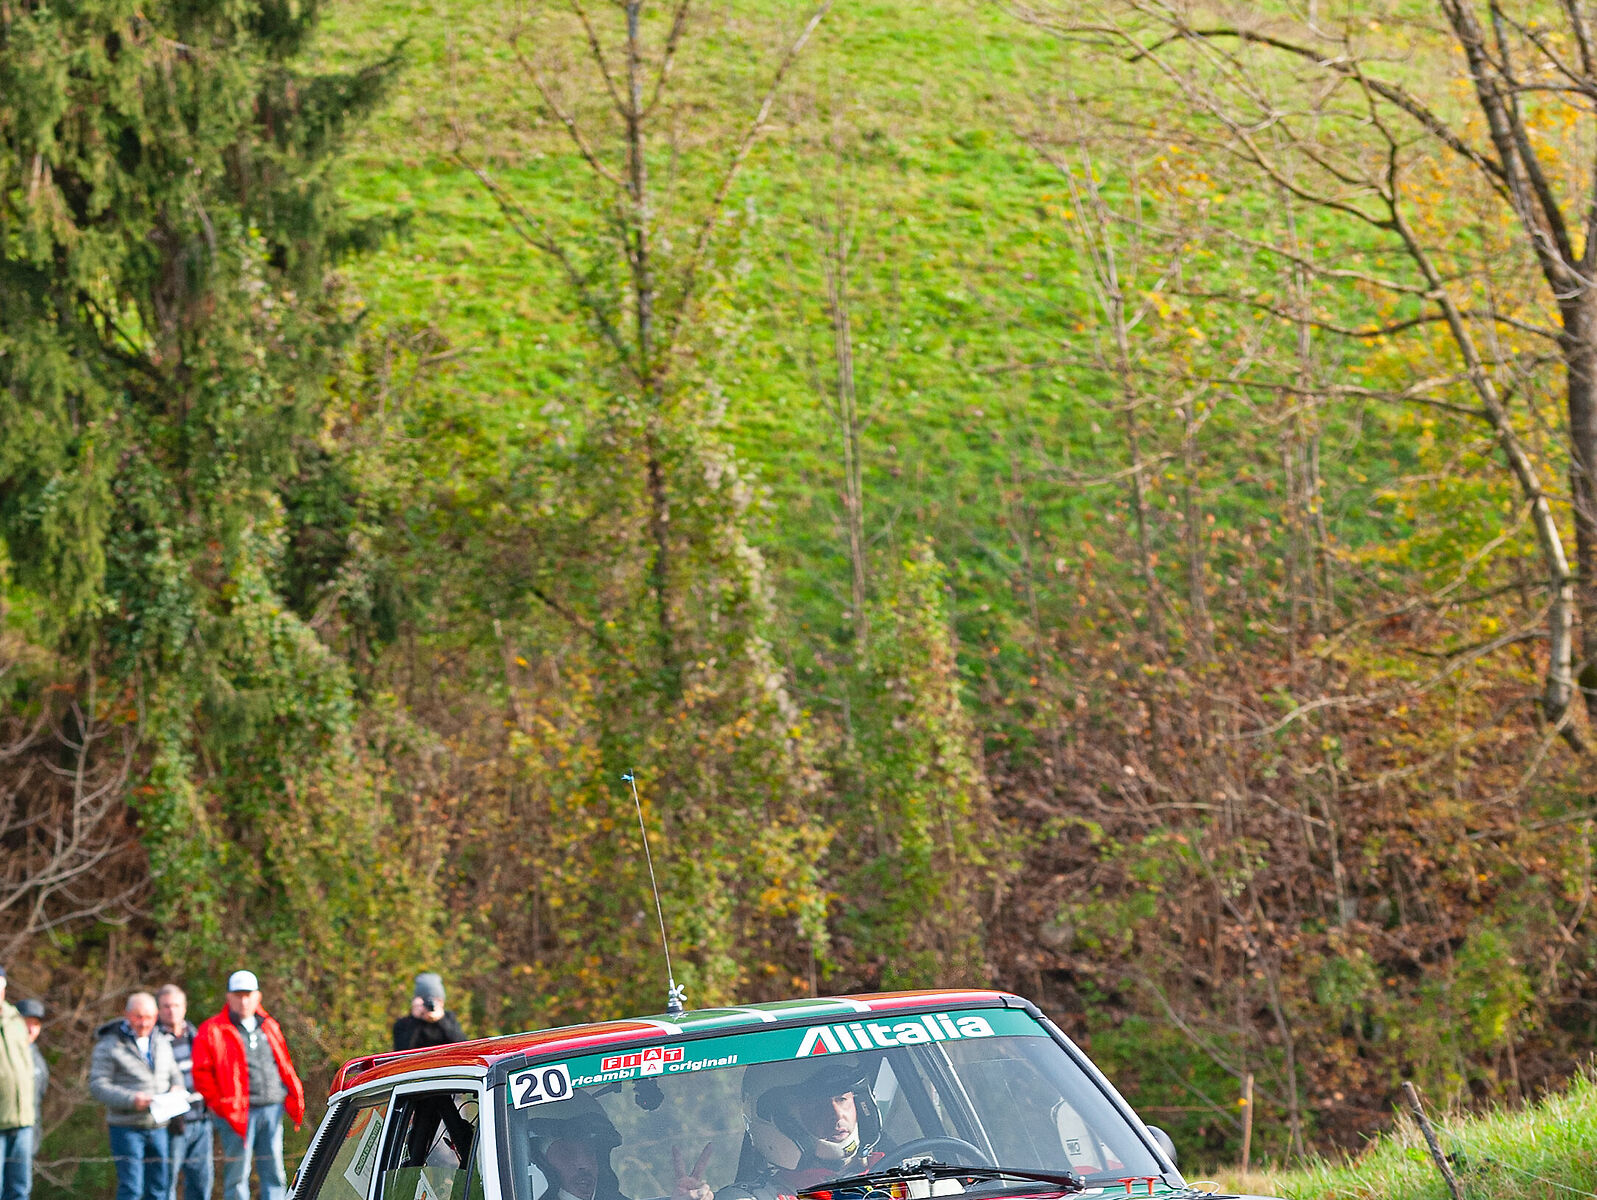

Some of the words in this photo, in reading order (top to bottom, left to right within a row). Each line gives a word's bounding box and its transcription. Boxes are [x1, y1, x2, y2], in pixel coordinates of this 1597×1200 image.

[796, 1013, 995, 1057] Alitalia
[571, 1069, 635, 1087] ricambi
[669, 1055, 738, 1072] originali
[603, 1047, 683, 1071] FIAT
[515, 1068, 568, 1106] 20
